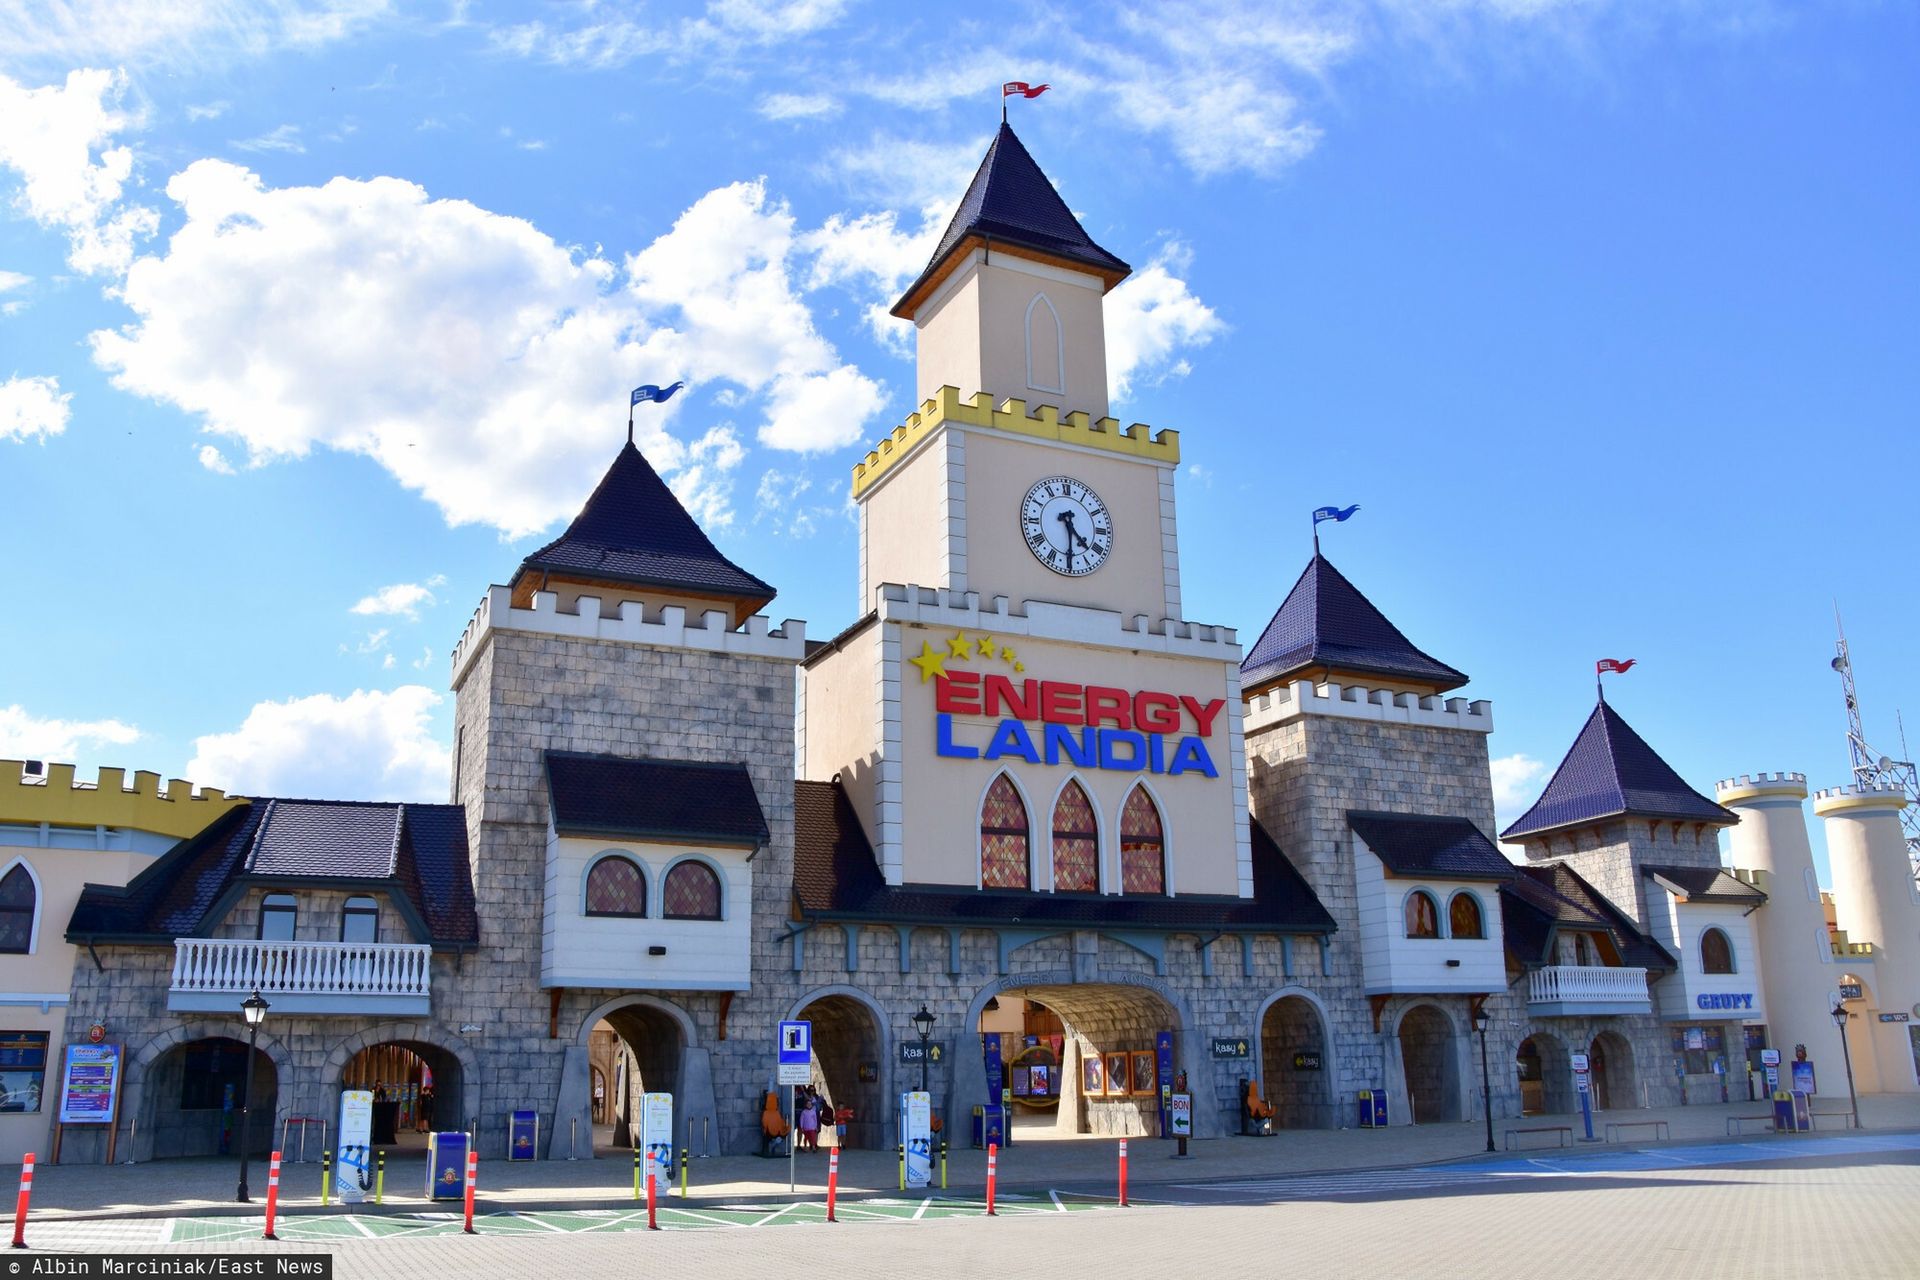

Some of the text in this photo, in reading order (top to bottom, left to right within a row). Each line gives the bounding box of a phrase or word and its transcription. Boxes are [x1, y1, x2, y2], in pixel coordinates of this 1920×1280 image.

[1005, 84, 1025, 92] EL
[634, 390, 653, 401] EL
[1316, 510, 1335, 520] EL
[1600, 662, 1617, 670] EL
[936, 670, 1226, 737] ENERGY
[936, 714, 1220, 778] LANDIA
[1698, 993, 1754, 1010] GRUPY
[1215, 1042, 1236, 1054] kasy
